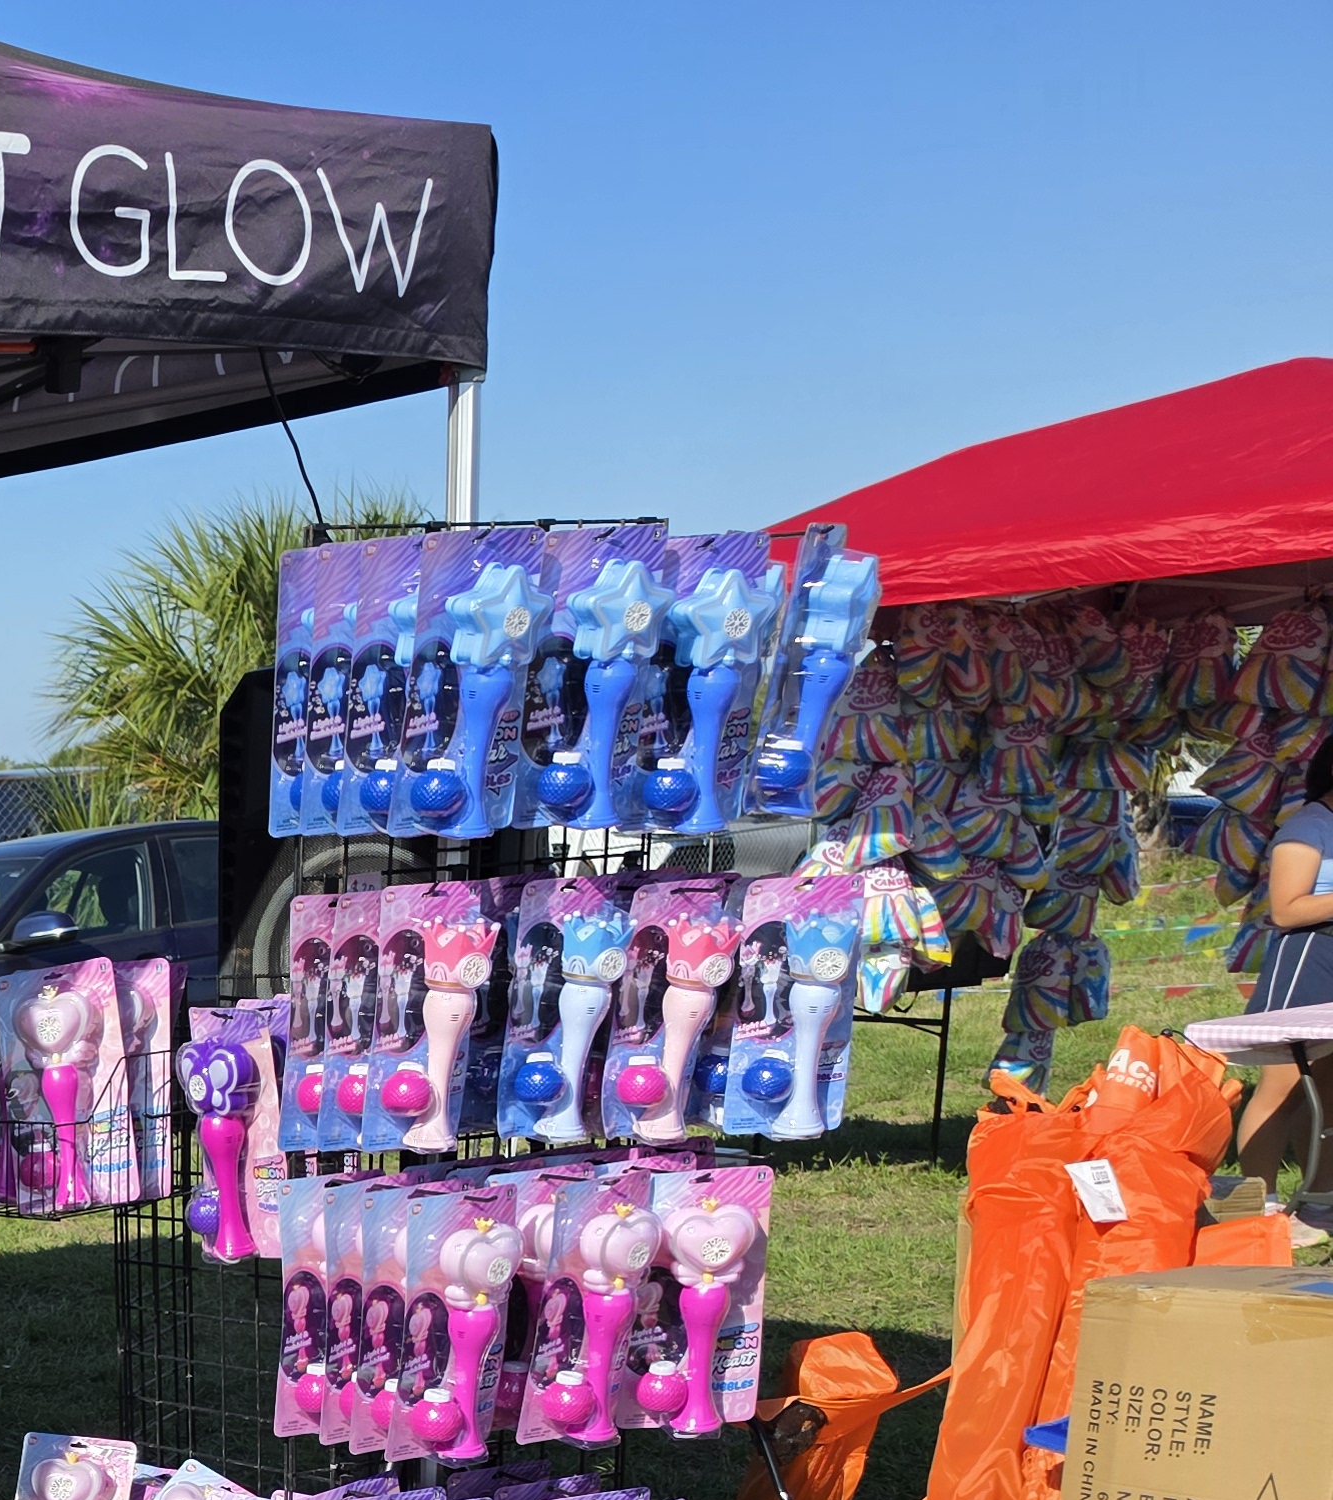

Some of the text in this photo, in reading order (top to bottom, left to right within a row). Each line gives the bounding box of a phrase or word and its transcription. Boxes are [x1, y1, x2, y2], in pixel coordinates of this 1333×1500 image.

[70, 145, 433, 297] GLOW
[495, 726, 516, 740] ON
[620, 720, 638, 732] ON
[726, 723, 748, 737] ON
[486, 772, 511, 787] BLES
[717, 769, 740, 783] BLES
[254, 1166, 285, 1179] NEON
[630, 1329, 653, 1341] ight
[716, 1336, 758, 1351] NEON
[712, 1378, 754, 1392] UBBLES
[1087, 1379, 1104, 1434] MADE
[1106, 1382, 1122, 1425] QTY:
[1124, 1384, 1144, 1433] SIZE:
[1144, 1388, 1167, 1462] COLOR:
[1169, 1390, 1192, 1458] STYLE:
[1193, 1393, 1217, 1456] NAME:
[1085, 1437, 1098, 1456] IN
